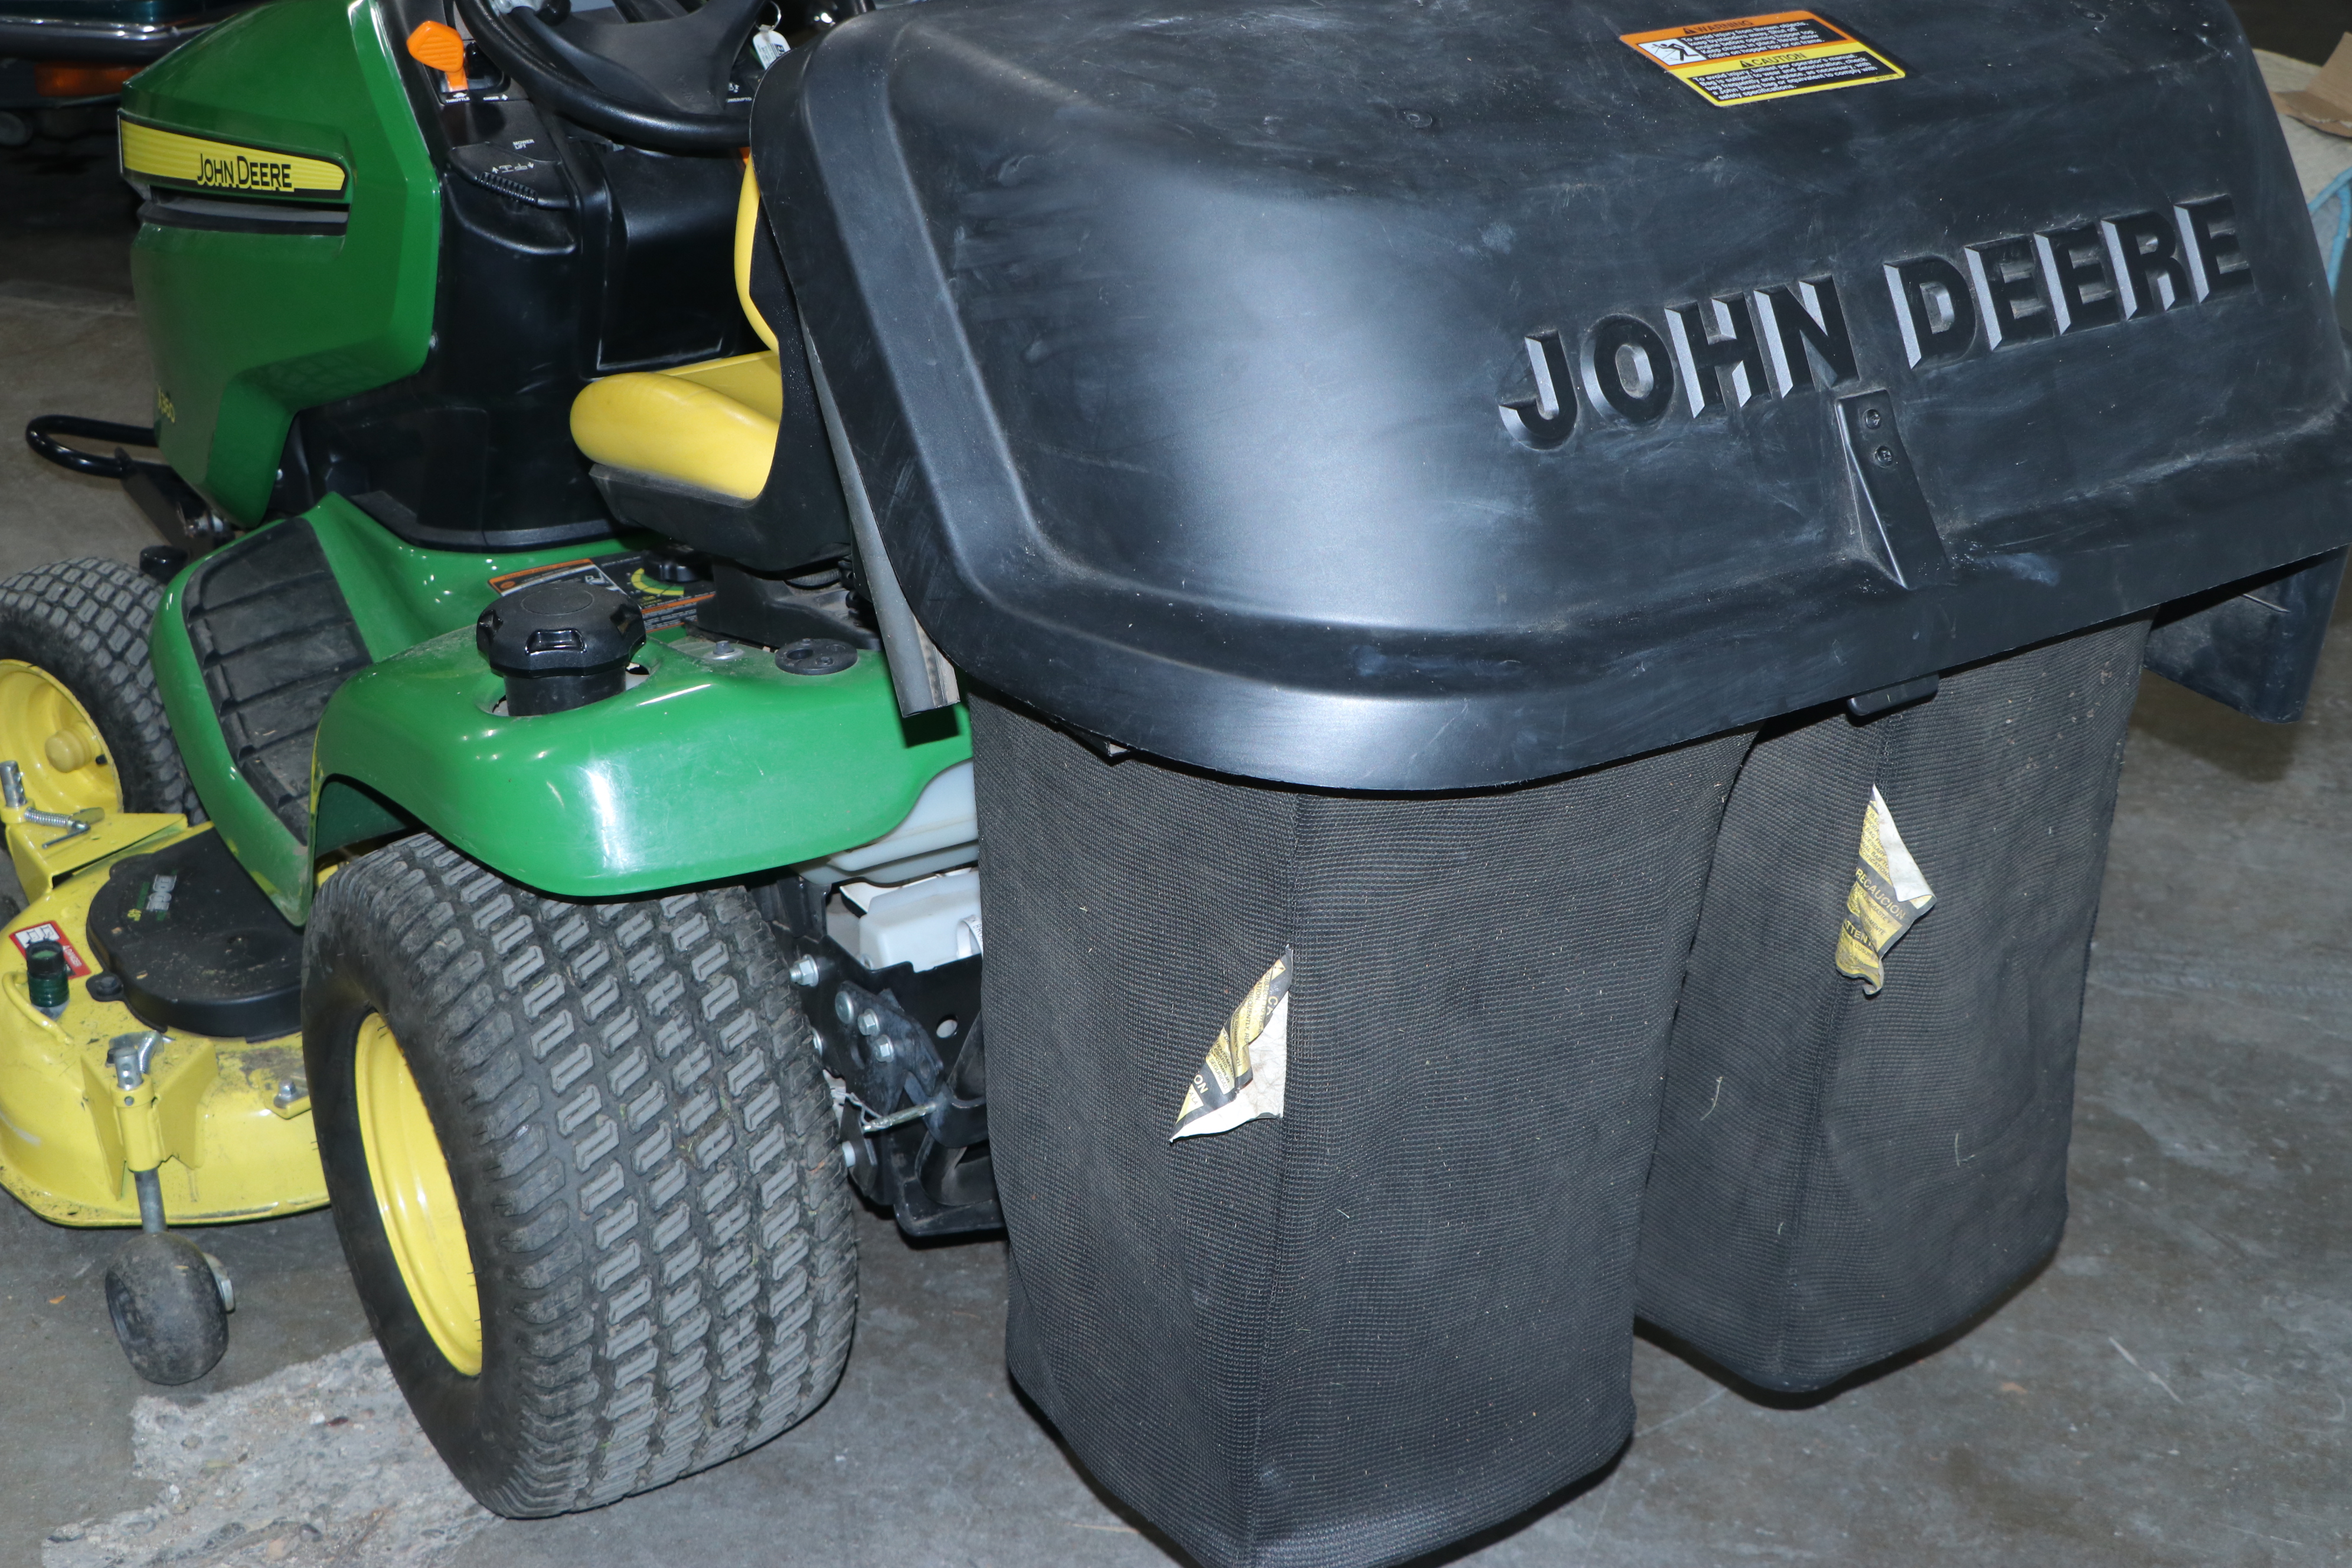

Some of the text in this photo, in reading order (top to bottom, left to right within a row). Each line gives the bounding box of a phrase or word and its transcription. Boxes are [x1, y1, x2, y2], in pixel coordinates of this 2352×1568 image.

[1693, 20, 1753, 33] WARNING
[1706, 35, 1748, 43] bystanders
[1751, 53, 1808, 66] CAUTION
[1791, 58, 1827, 67] operator's
[1795, 61, 1845, 71] deterioration,
[1720, 79, 1760, 89] frequently
[1817, 65, 1856, 73] necessary,
[1786, 74, 1824, 83] equivalent
[1742, 84, 1795, 96] specifications.
[197, 153, 294, 190] JOHN DEERE
[1498, 195, 2253, 450] JOHN DEERE
[1864, 827, 1877, 838] BAG
[1870, 850, 1883, 863] BAG
[146, 874, 177, 912] EDGE
[1856, 867, 1906, 920] RECAUCION
[1261, 972, 1270, 1001] SUBJECT
[1213, 1057, 1232, 1083] CUMPLIR
